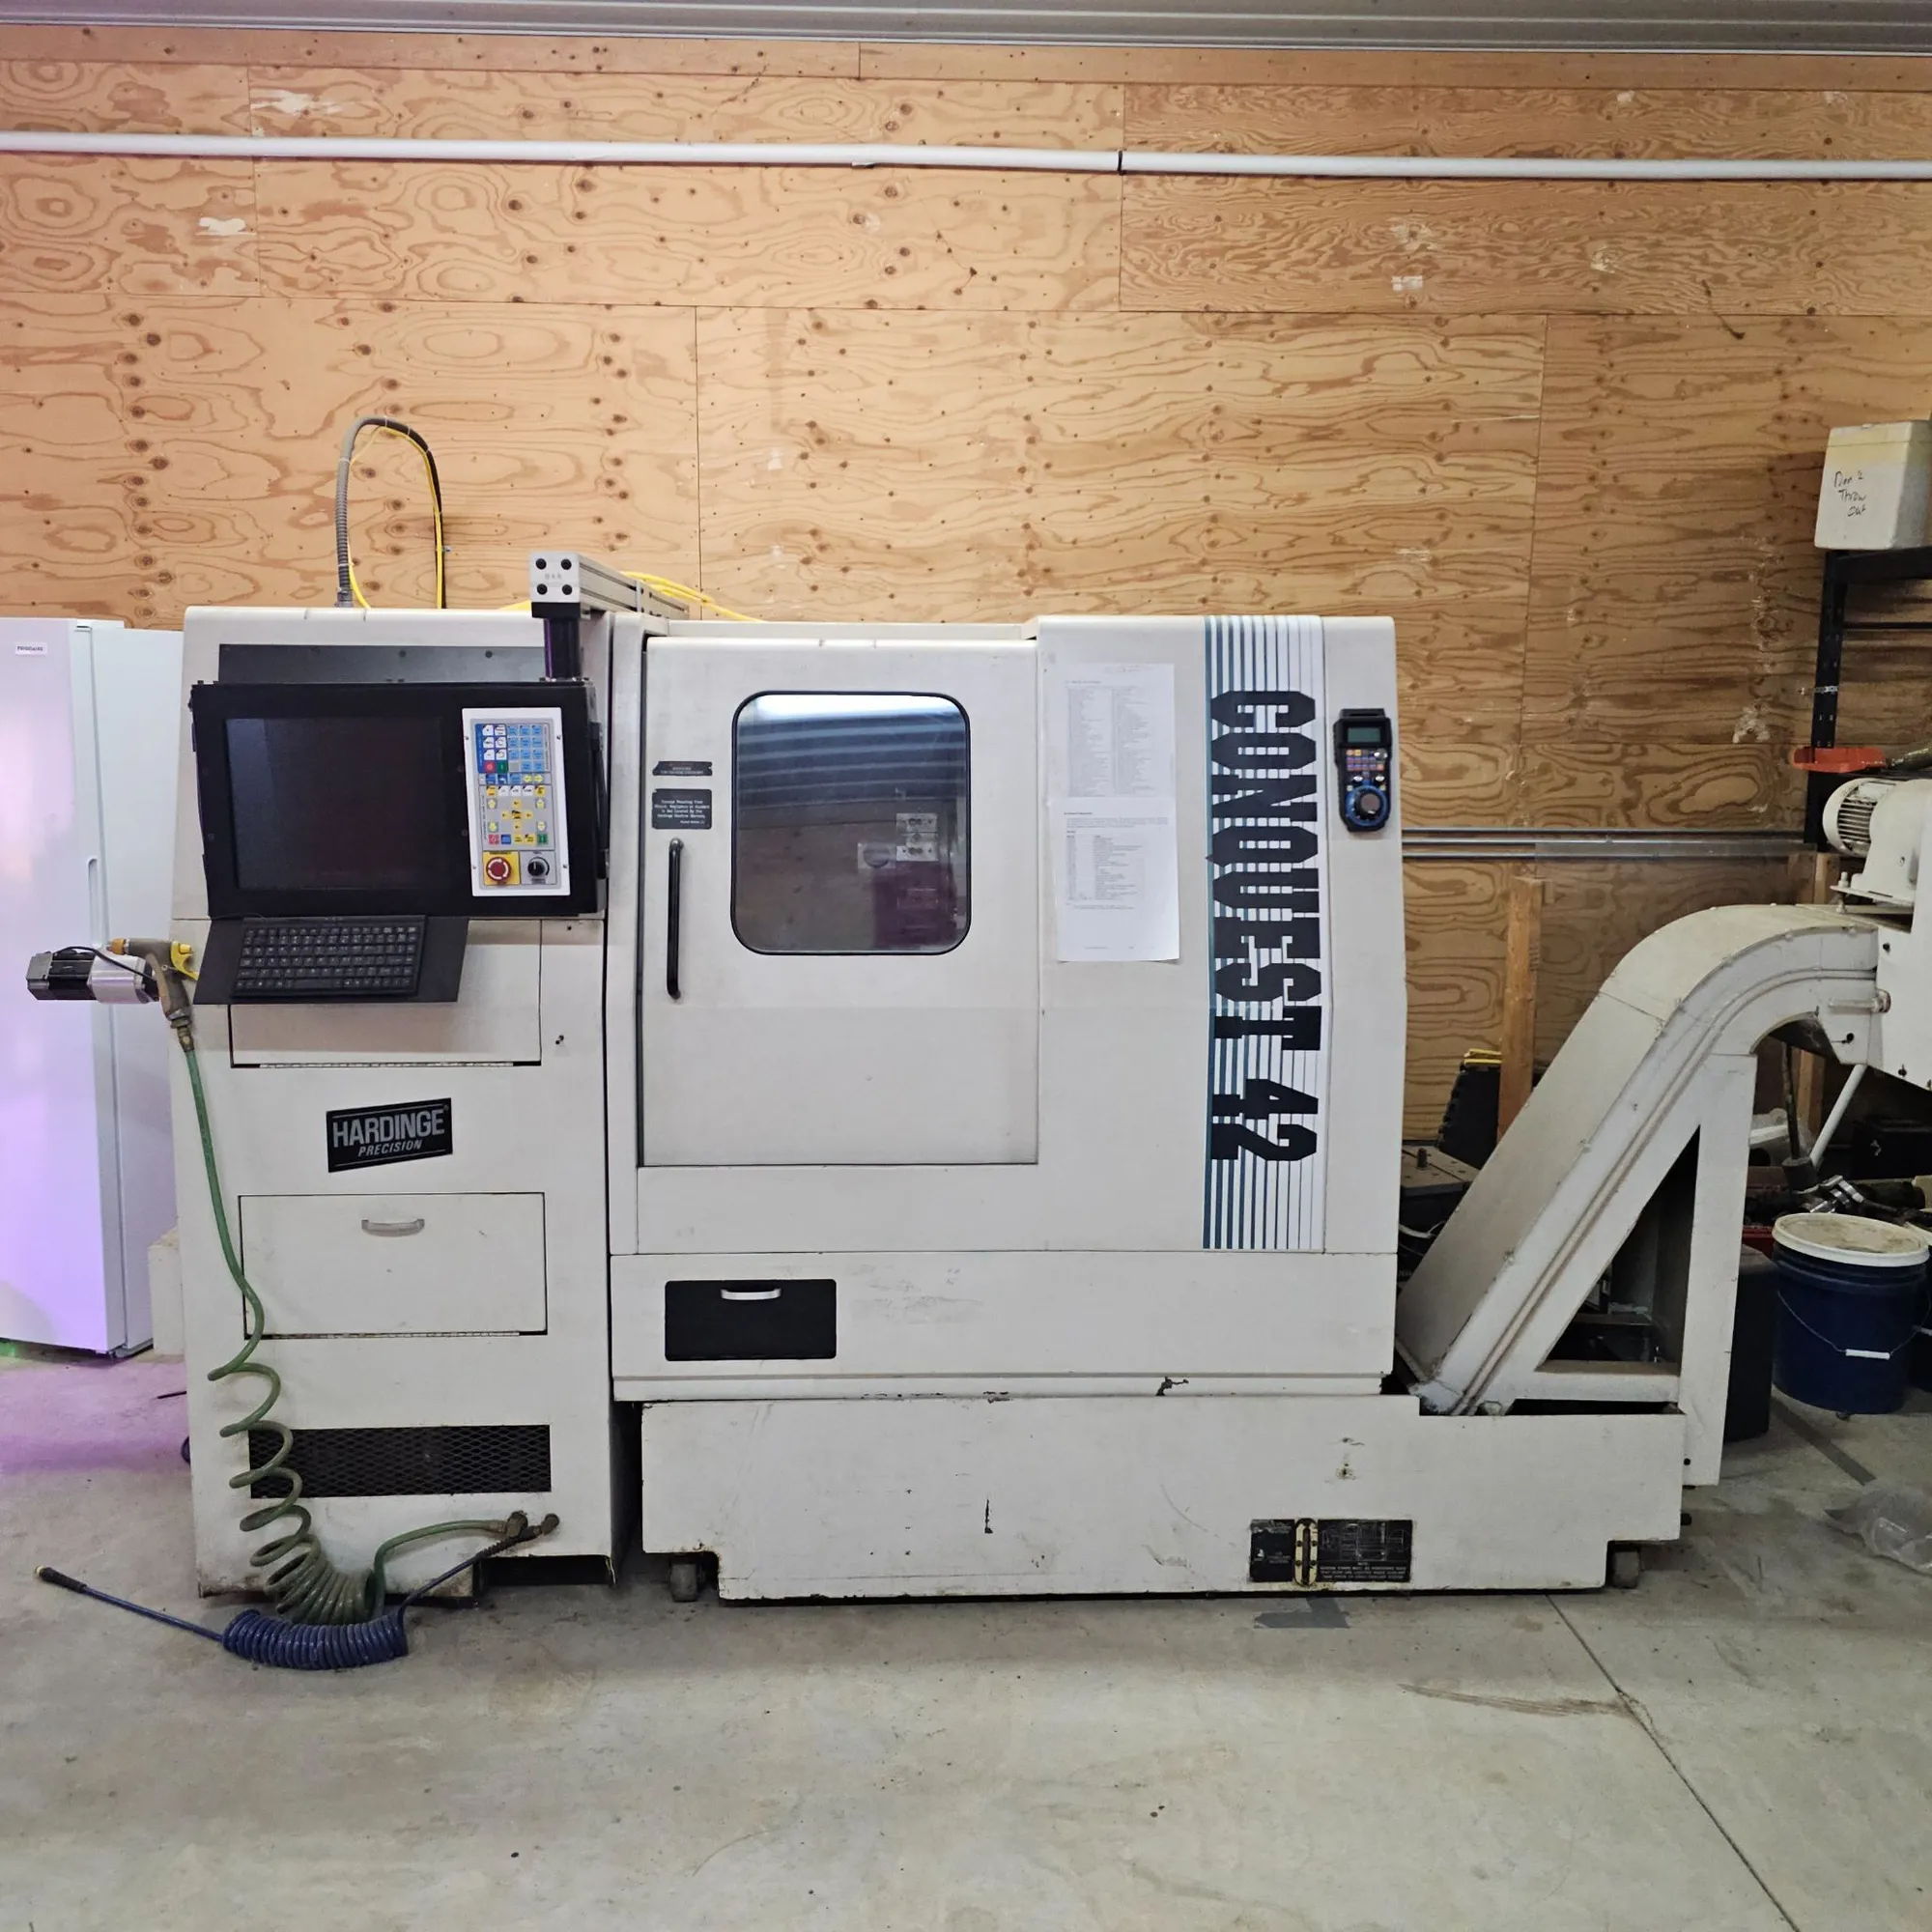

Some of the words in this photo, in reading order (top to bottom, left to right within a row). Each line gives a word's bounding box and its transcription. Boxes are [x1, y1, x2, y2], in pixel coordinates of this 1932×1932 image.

[1206, 691, 1321, 1051] CONQUEST
[333, 1109, 444, 1148] HARDINGE
[357, 1140, 422, 1157] PRECISION
[1211, 1078, 1319, 1161] 42
